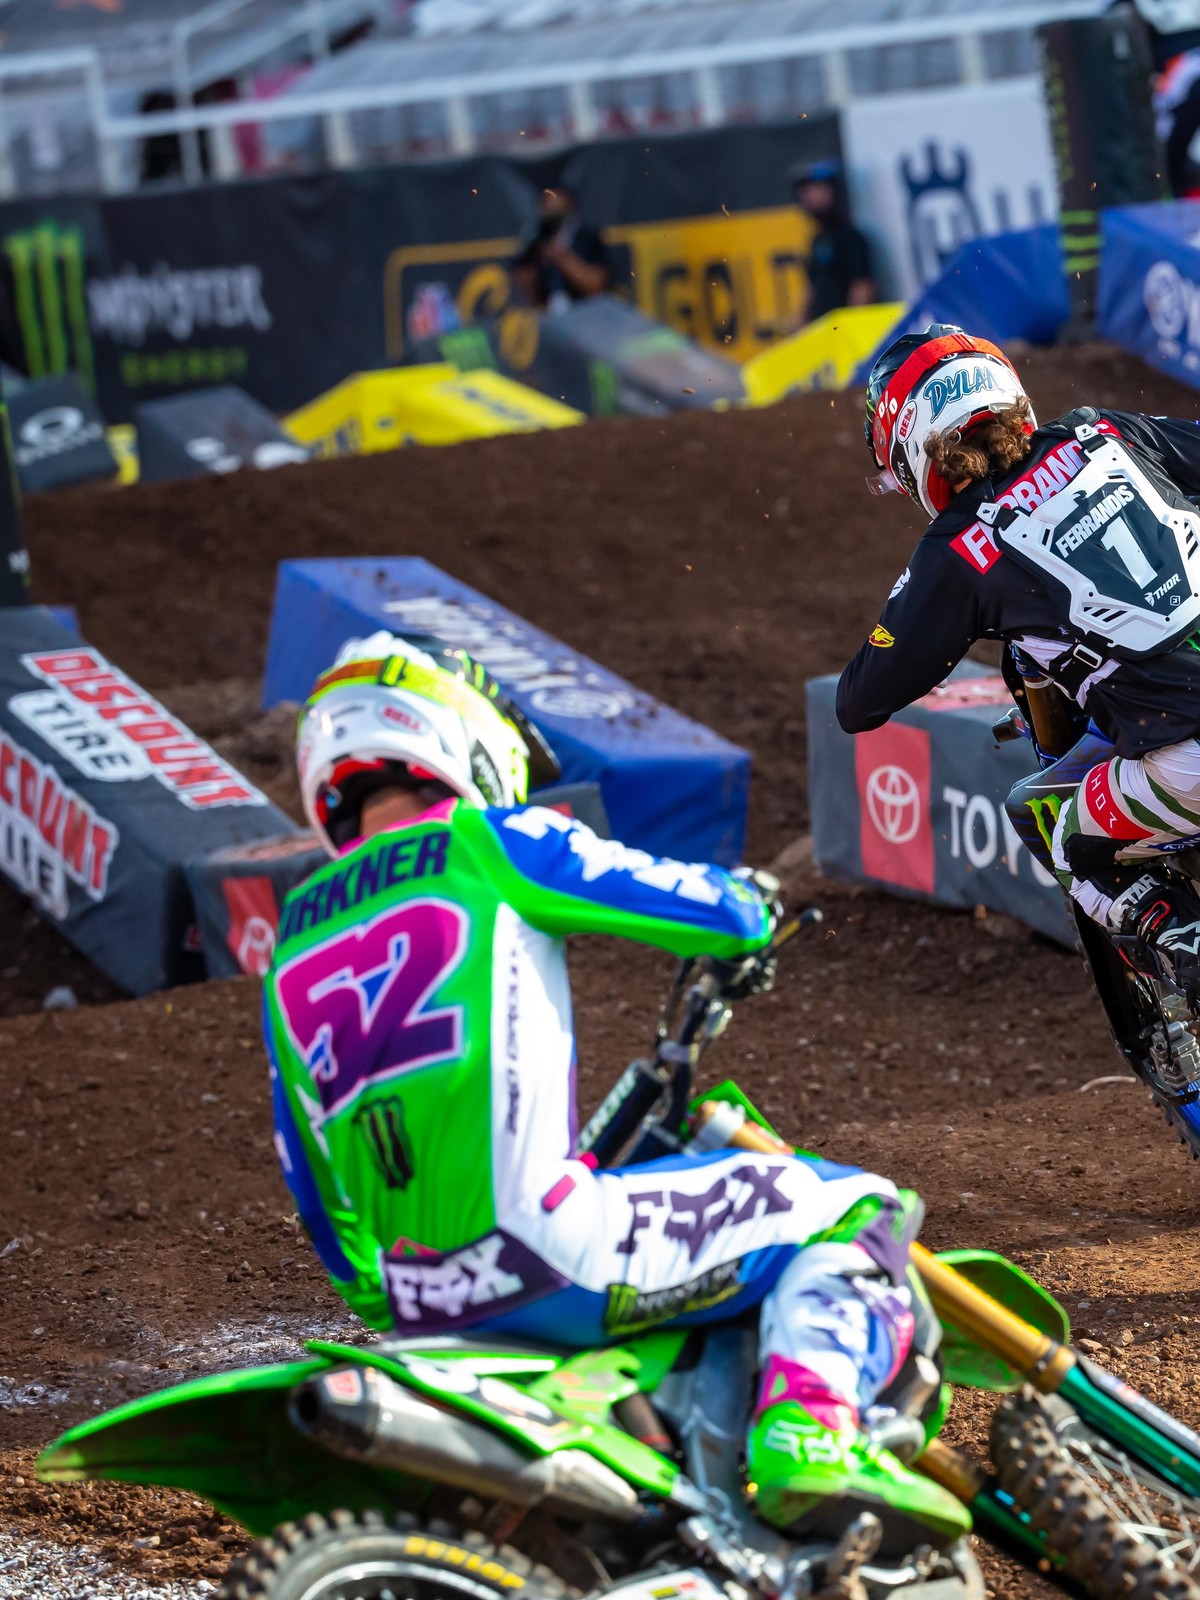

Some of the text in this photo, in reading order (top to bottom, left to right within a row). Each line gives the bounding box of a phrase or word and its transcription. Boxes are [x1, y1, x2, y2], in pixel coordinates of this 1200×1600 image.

[898, 406, 916, 439] BELL
[1054, 484, 1136, 559] FERRANDIS
[1100, 515, 1159, 590] 1
[1152, 573, 1182, 600] THOR
[32, 702, 133, 769] TIRE
[34, 653, 251, 805] DISCOUNT
[274, 897, 468, 1113] 52
[403, 1534, 526, 1590] DUNLOP
